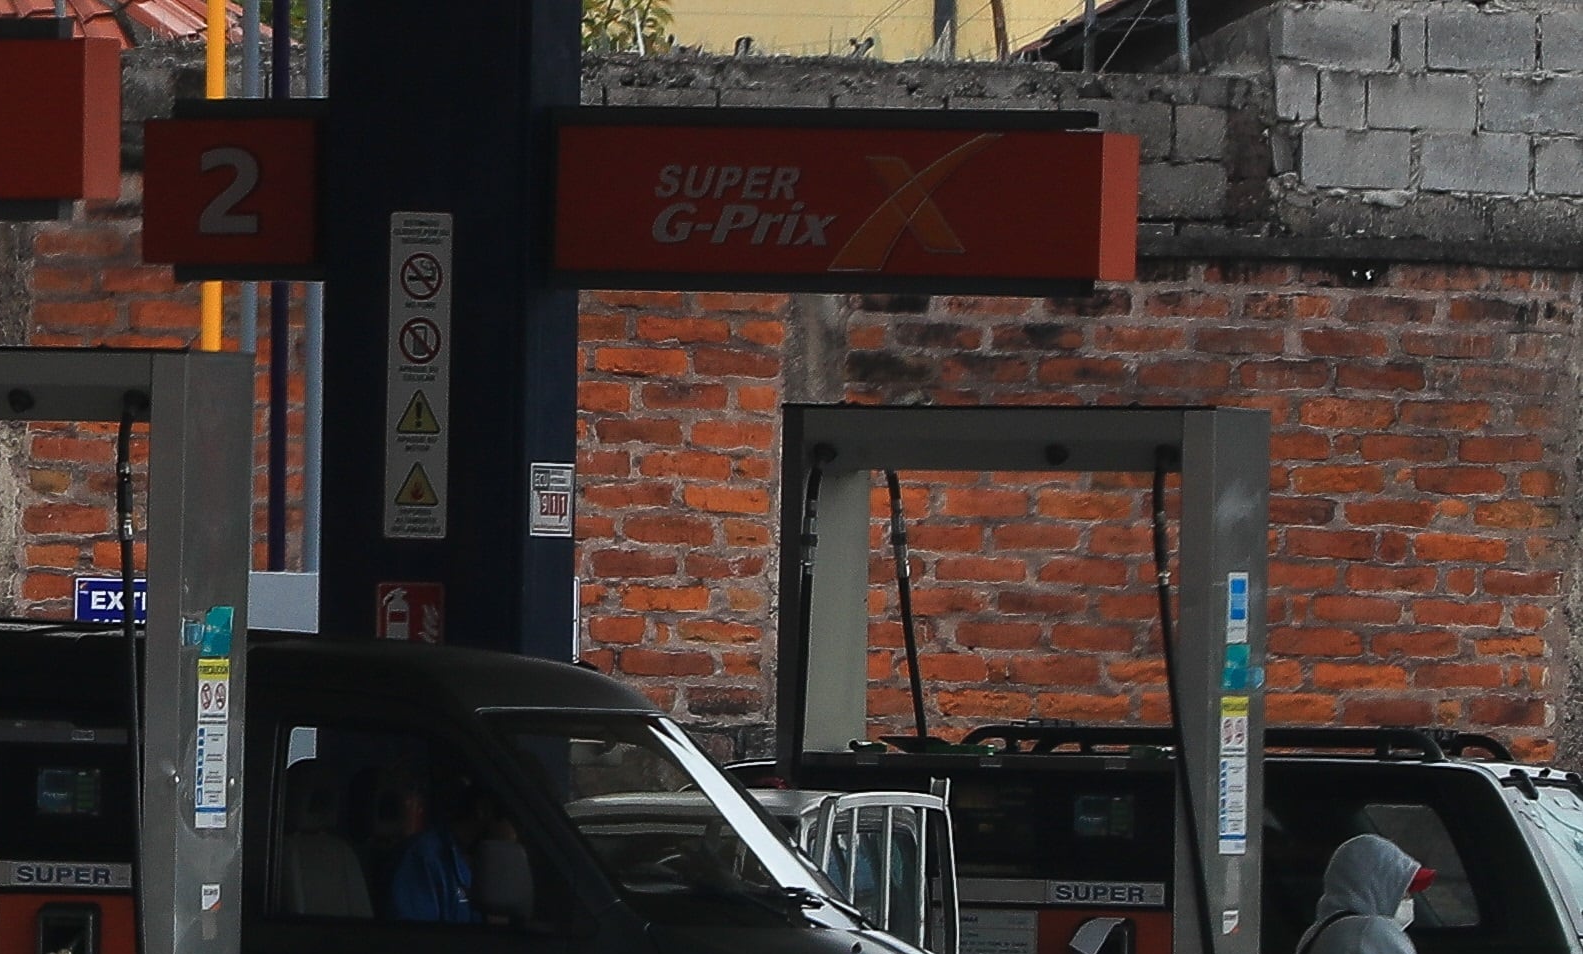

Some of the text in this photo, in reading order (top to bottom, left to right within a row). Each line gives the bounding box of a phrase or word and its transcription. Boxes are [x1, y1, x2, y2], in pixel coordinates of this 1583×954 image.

[197, 147, 261, 235] 2
[652, 165, 801, 200] SUPER
[651, 201, 837, 247] G-Prix
[15, 864, 112, 885] SUPER
[1054, 883, 1146, 904] SUPER
